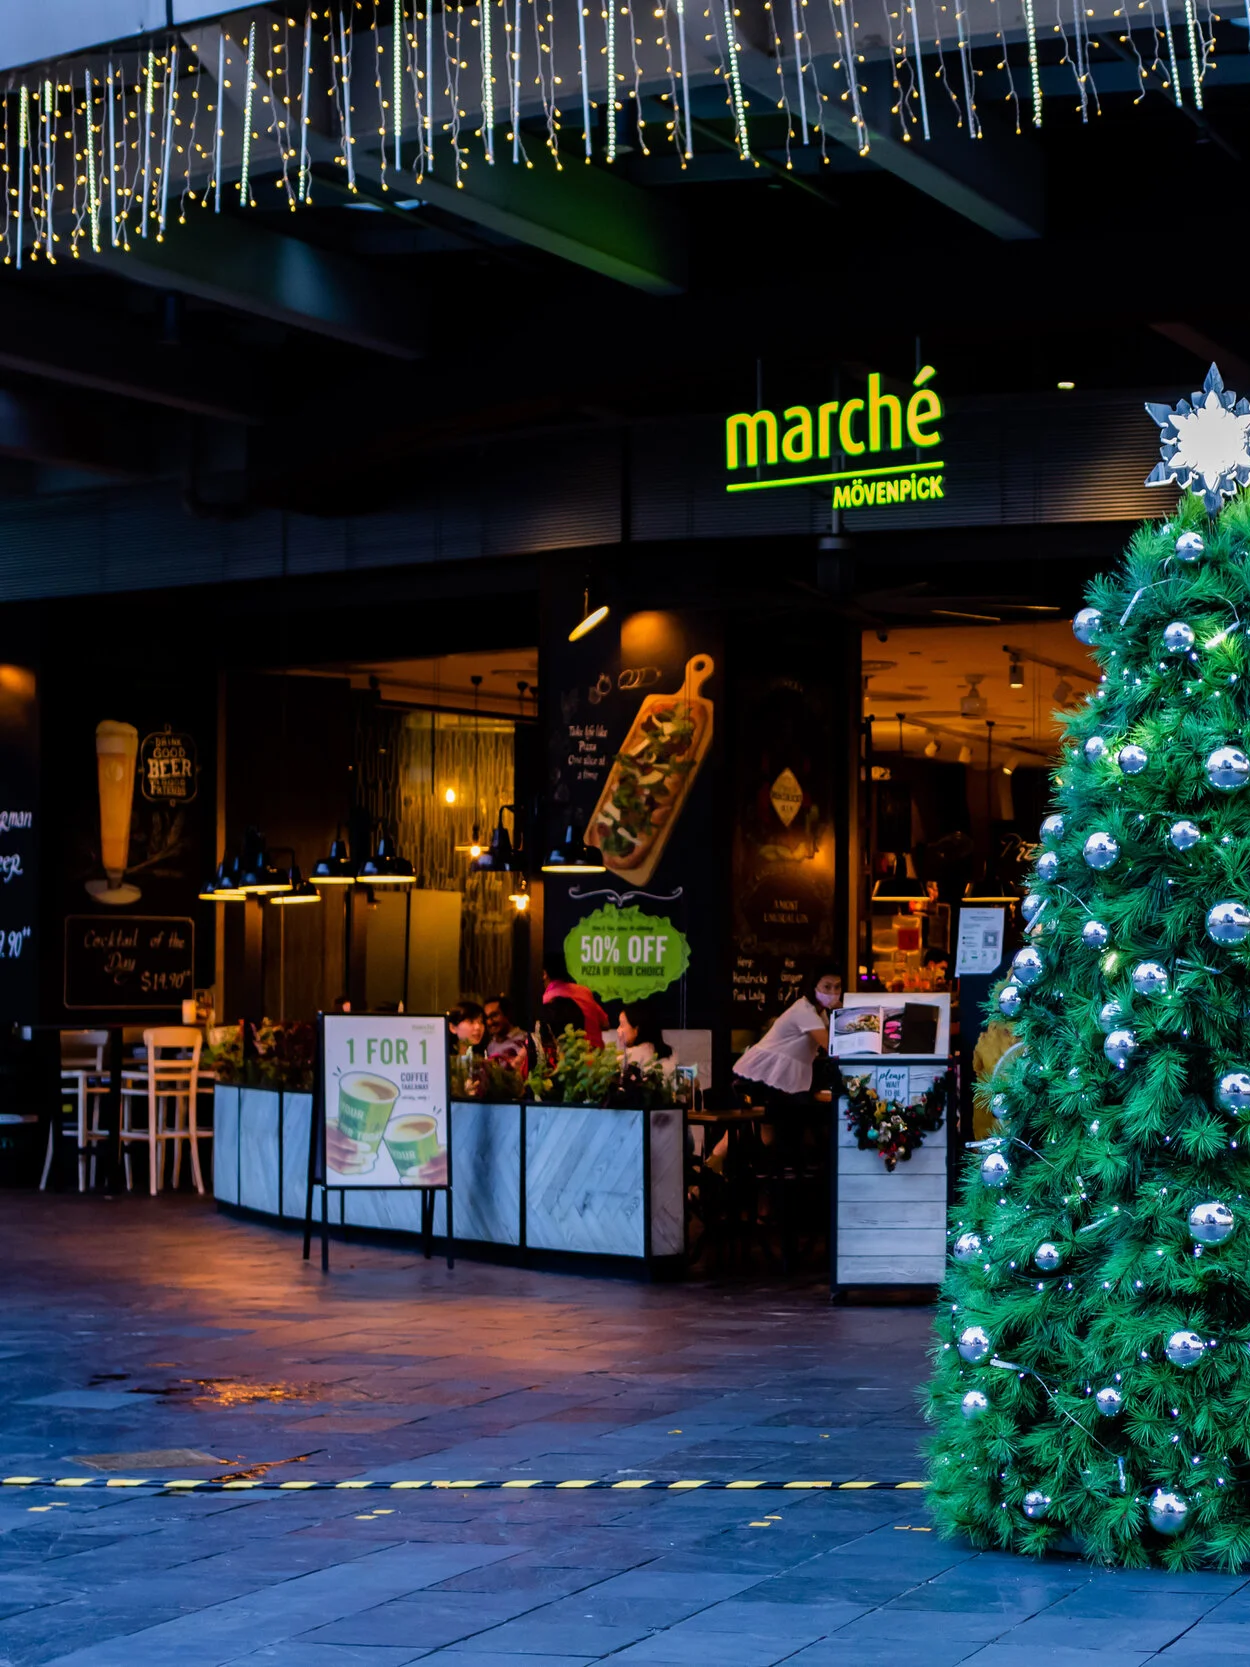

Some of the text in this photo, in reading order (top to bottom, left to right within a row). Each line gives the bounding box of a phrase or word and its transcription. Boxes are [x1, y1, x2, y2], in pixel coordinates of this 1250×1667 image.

[726, 365, 942, 470] marché
[153, 747, 186, 758] GOOD
[147, 758, 192, 778] BEER
[581, 935, 669, 964] 50% OFF
[581, 966, 601, 977] PIZZA
[613, 966, 633, 977] YOUR
[635, 966, 665, 977] CHOICE
[347, 1038, 427, 1065] 1 FOR 1
[400, 1072, 429, 1082] COFFEE
[878, 1068, 906, 1082] please
